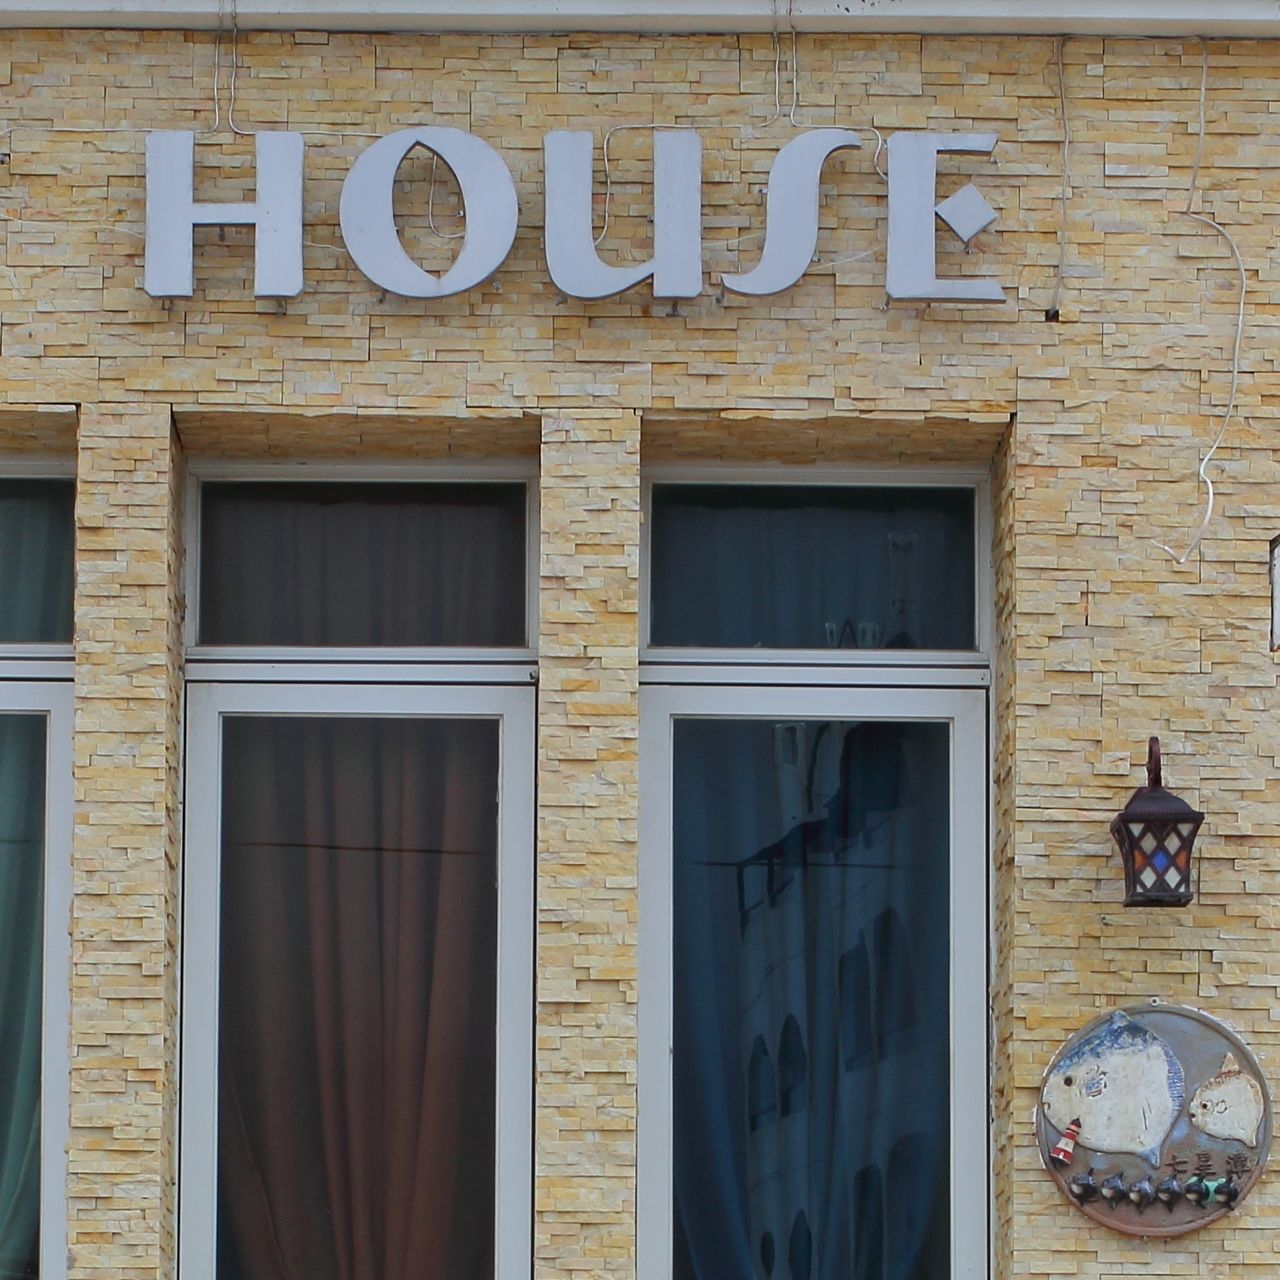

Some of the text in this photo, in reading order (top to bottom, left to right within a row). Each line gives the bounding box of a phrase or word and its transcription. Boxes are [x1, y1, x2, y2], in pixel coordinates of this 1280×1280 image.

[142, 124, 1007, 304] HOUSE
[1165, 1150, 1251, 1180] 七星潭
